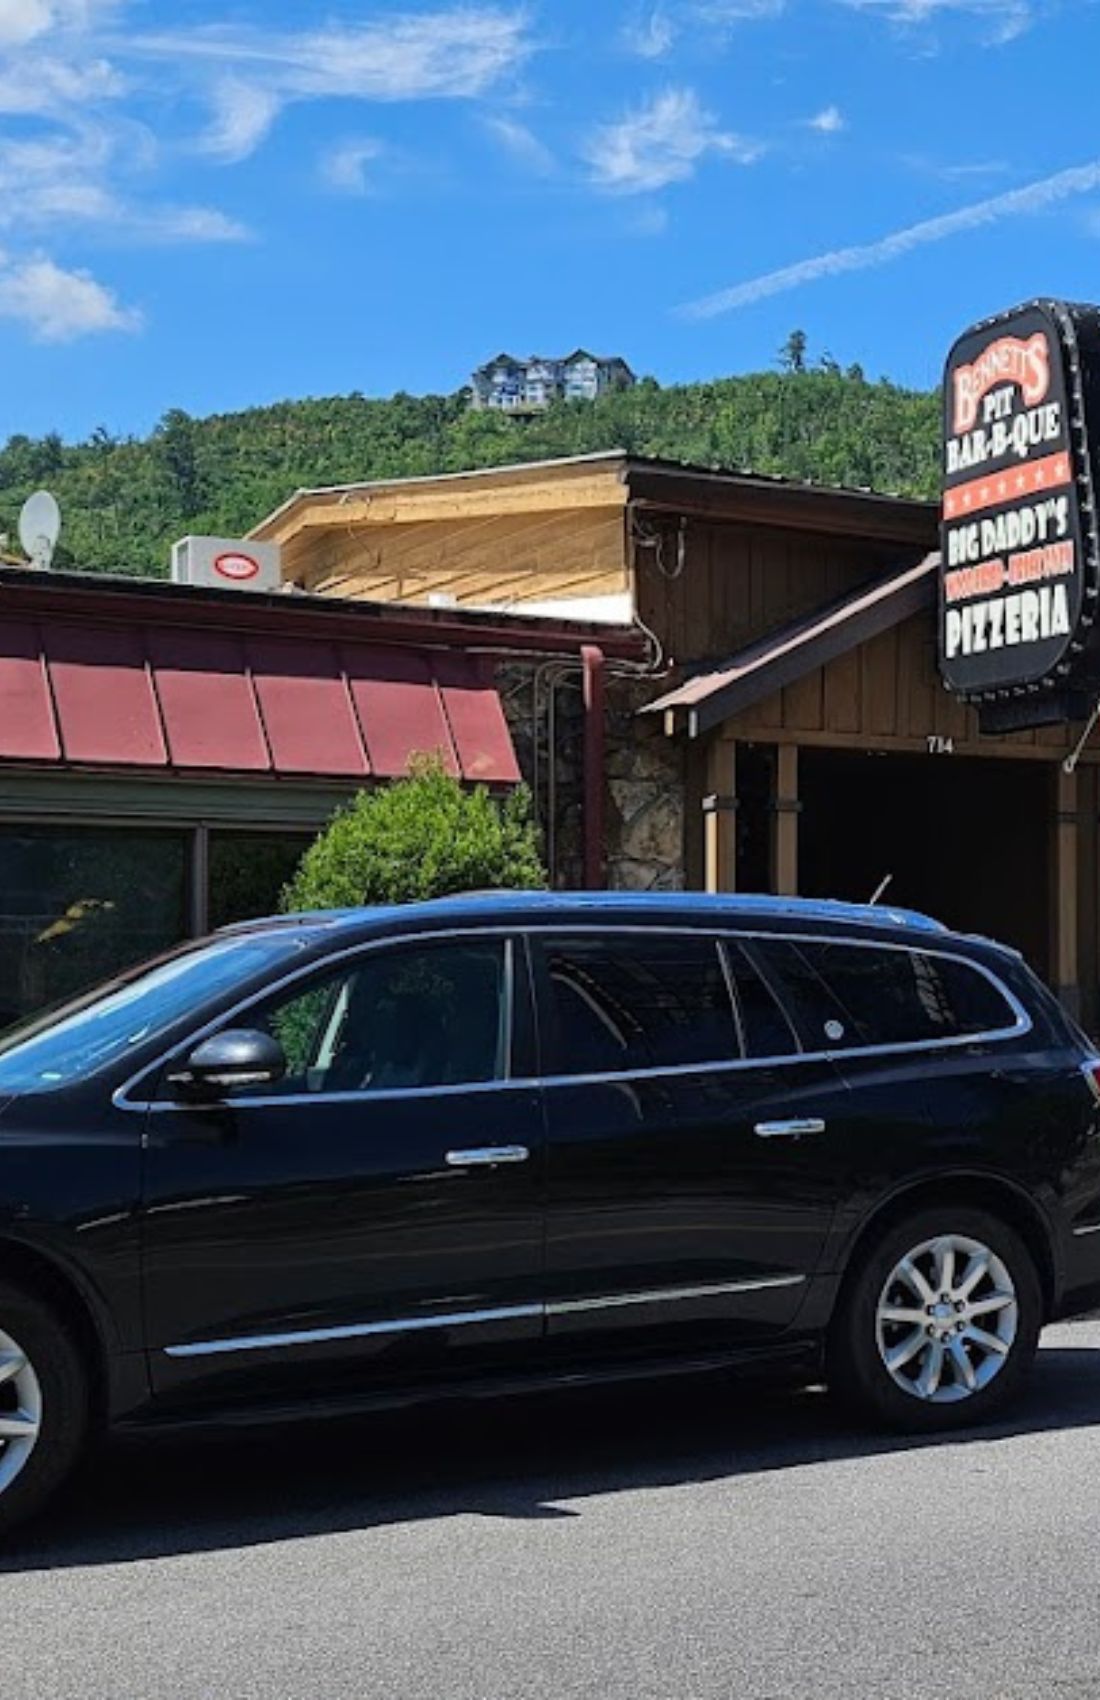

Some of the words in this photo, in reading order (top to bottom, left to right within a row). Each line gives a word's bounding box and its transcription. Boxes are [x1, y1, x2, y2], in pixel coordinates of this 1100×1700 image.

[946, 402, 1060, 474] BAR-B-QUE
[983, 385, 1014, 423] PIT
[948, 523, 980, 566] BIG
[981, 496, 1069, 556] DADDY'S
[946, 584, 1069, 658] PIZZERIA
[927, 736, 952, 753] 714
